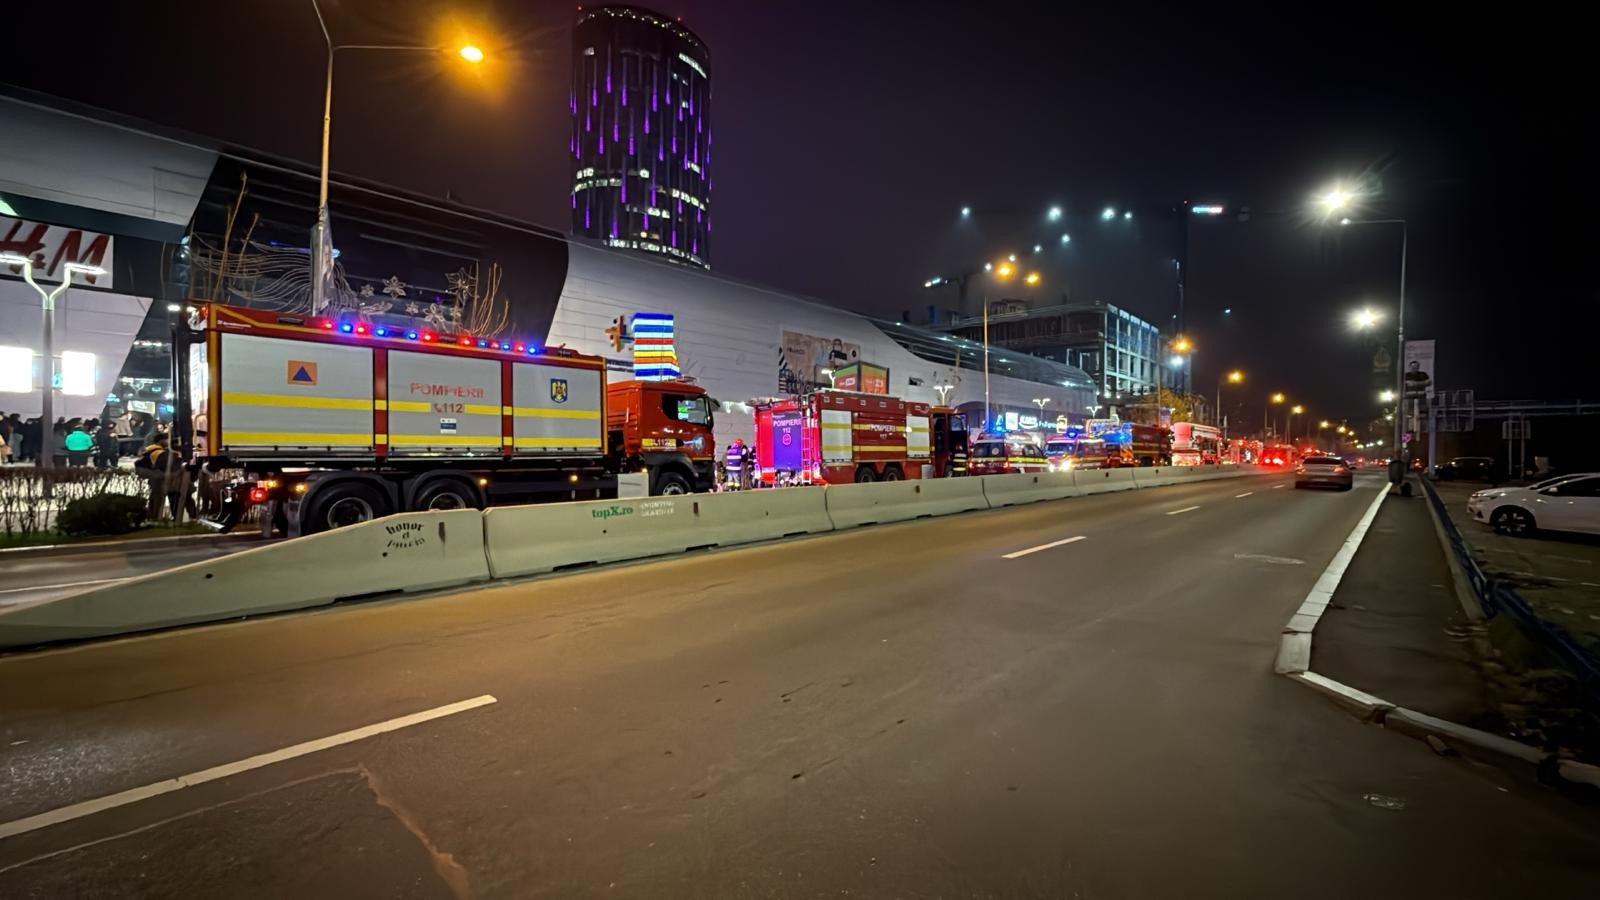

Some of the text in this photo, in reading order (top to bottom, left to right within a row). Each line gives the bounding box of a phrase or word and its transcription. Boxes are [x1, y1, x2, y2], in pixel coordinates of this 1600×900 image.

[444, 403, 463, 413] 112
[592, 506, 633, 518] topX.ro
[386, 523, 424, 534] honor
